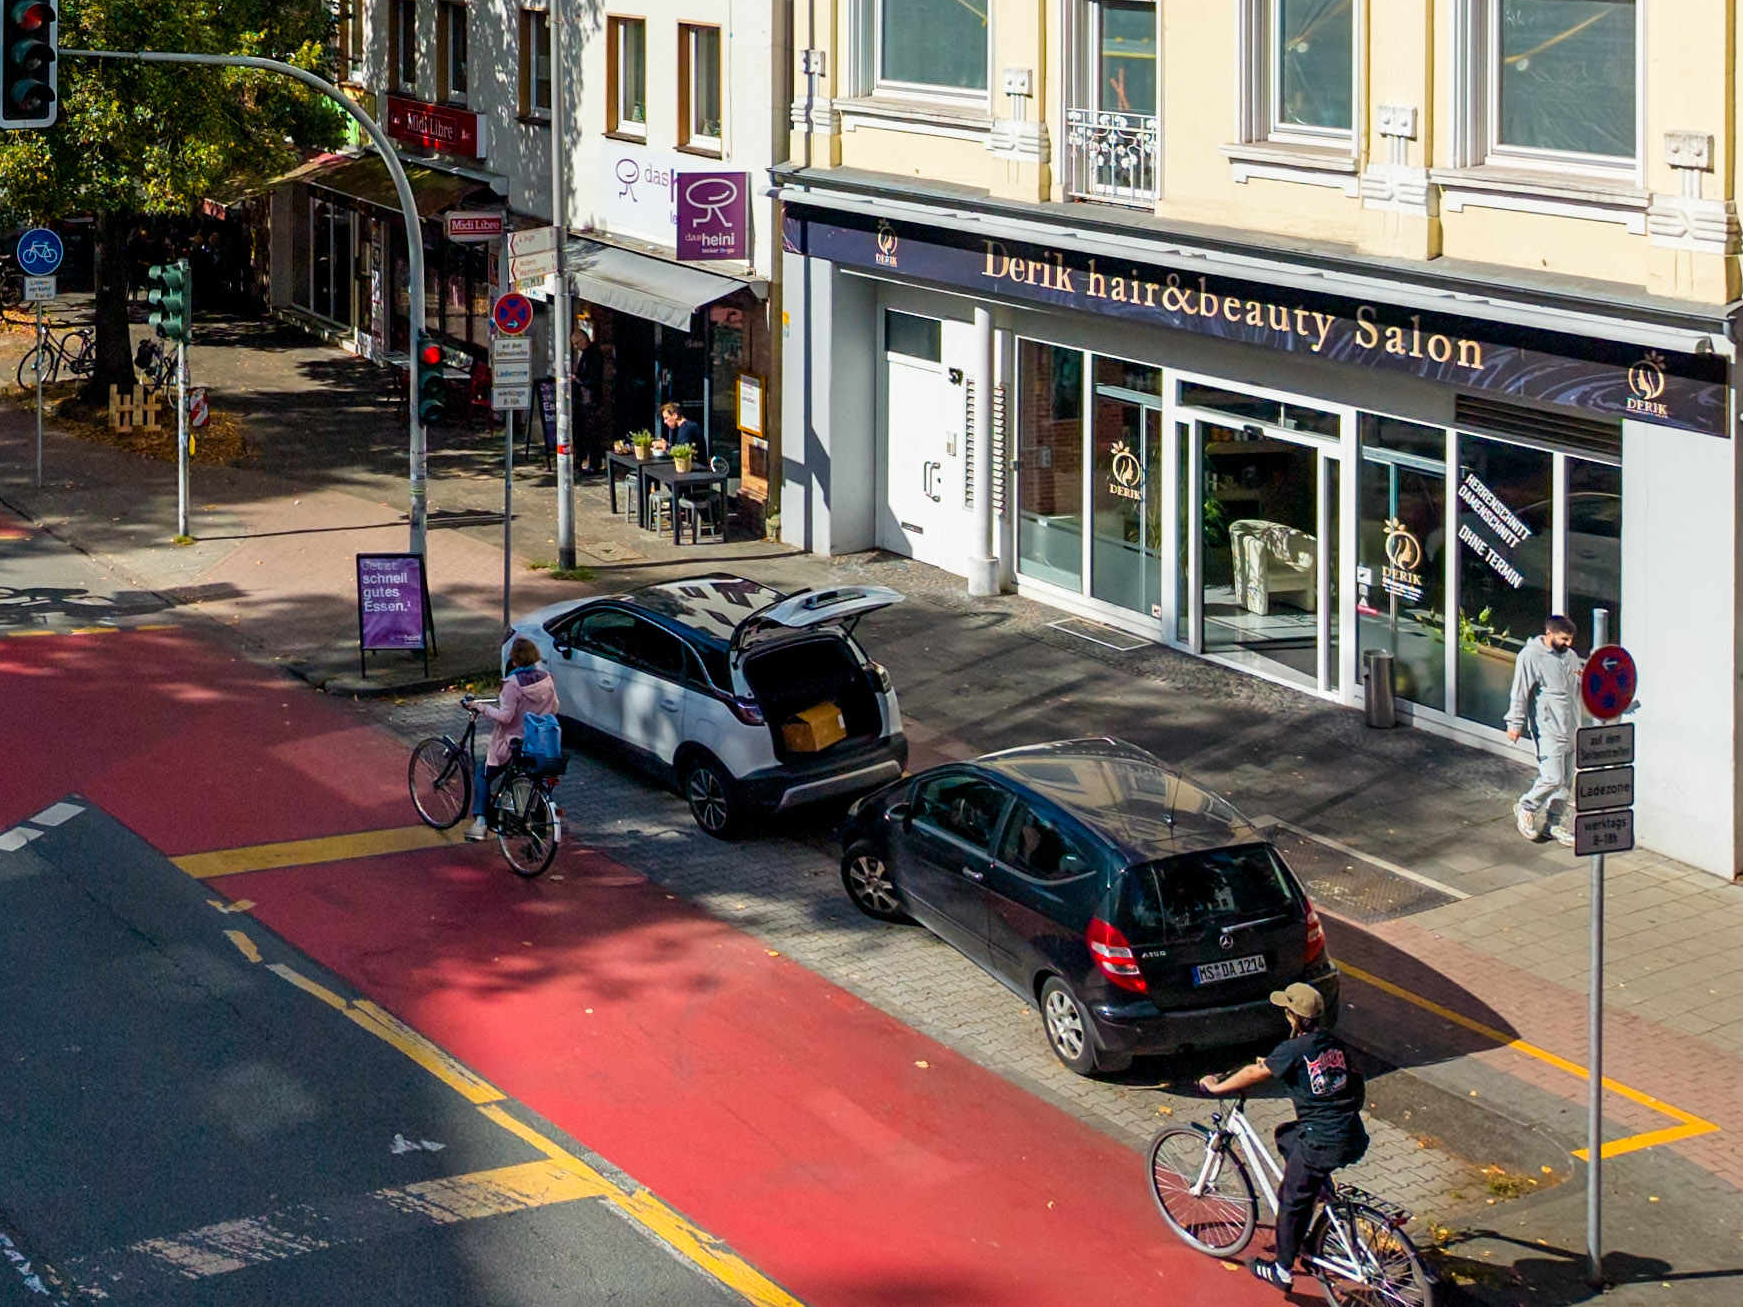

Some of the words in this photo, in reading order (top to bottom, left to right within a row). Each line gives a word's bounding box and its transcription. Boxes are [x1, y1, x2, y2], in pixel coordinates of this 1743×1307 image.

[407, 112, 428, 133] Midi
[430, 118, 453, 139] Libre
[452, 220, 474, 230] Midi
[475, 220, 499, 230] Libre
[982, 240, 1075, 293] Derik
[1087, 258, 1335, 352] hair&beauty
[1356, 305, 1484, 370] Salon
[1626, 397, 1668, 415] DERIK
[1109, 483, 1142, 501] DERIK
[1465, 473, 1532, 540] HERRENSCHNITT
[1458, 485, 1521, 548] DAMENSCHNITT
[1458, 524, 1488, 556] OHNE
[1485, 547, 1524, 589] TERMIN
[363, 573, 407, 584] schnell
[1382, 565, 1422, 586] DERIK
[363, 587, 400, 600] gutes
[1580, 783, 1630, 798] Ladezone
[1584, 818, 1627, 831] werktags
[1199, 964, 1215, 982] MS
[1221, 960, 1237, 978] DA
[1238, 956, 1265, 974] 1214
